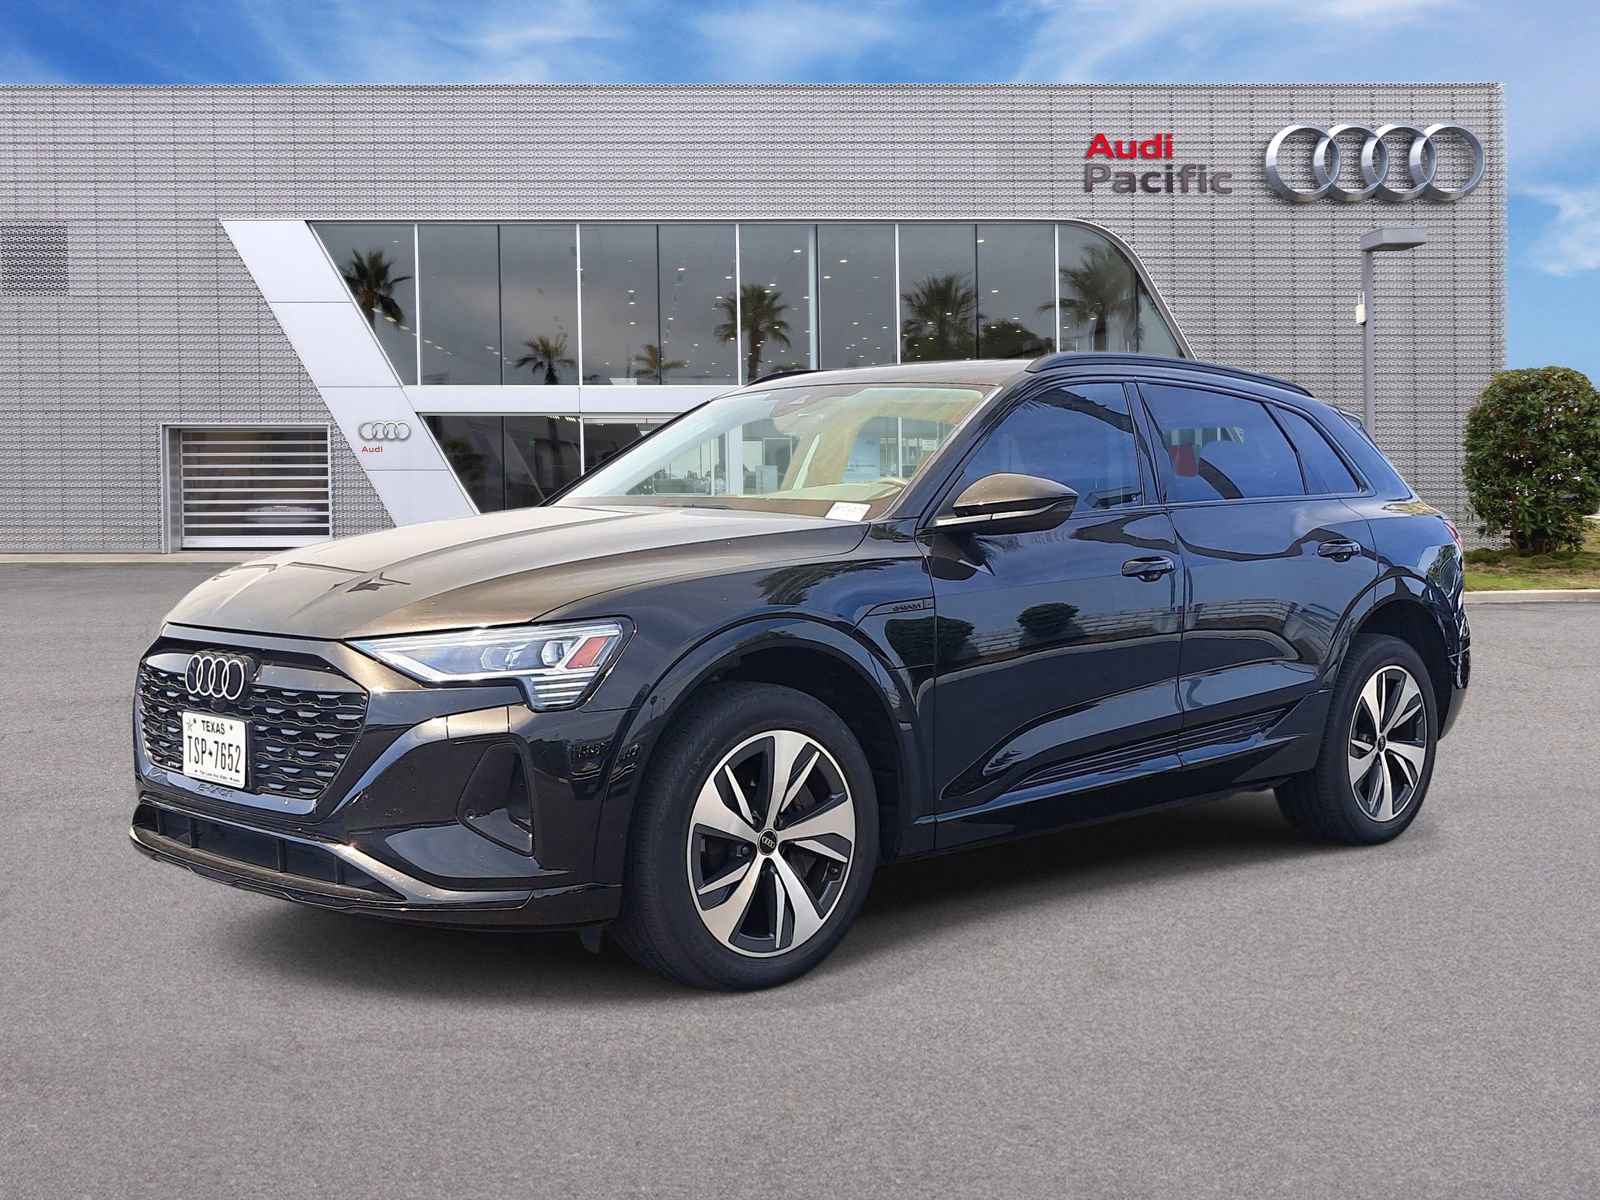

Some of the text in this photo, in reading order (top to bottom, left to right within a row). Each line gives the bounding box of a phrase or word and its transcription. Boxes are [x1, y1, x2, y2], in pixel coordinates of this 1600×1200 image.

[1084, 132, 1173, 160] Audi
[1084, 163, 1233, 194] Pacific
[361, 445, 384, 453] Audi
[201, 719, 226, 735] TEXAS
